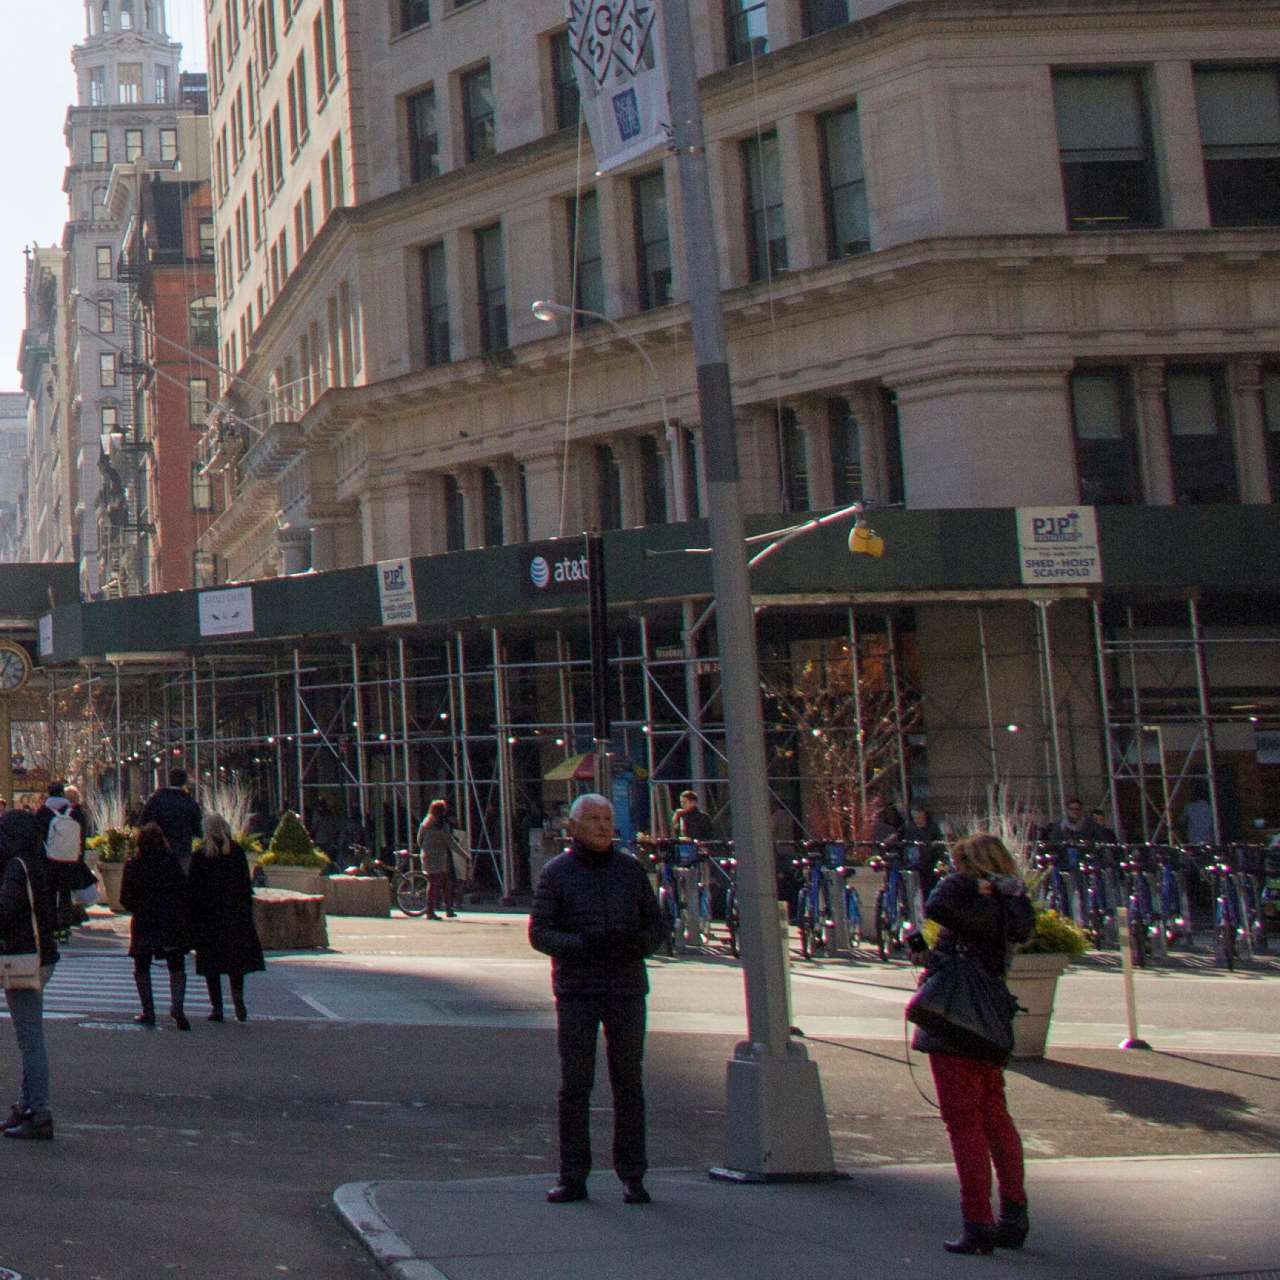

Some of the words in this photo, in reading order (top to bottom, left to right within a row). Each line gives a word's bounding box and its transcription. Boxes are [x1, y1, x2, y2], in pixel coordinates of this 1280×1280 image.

[1032, 518, 1070, 535] PJP
[554, 555, 590, 581] at&t
[1025, 559, 1054, 568] SHED
[1062, 558, 1095, 568] HOIST
[1033, 568, 1089, 578] SCAFFOLD
